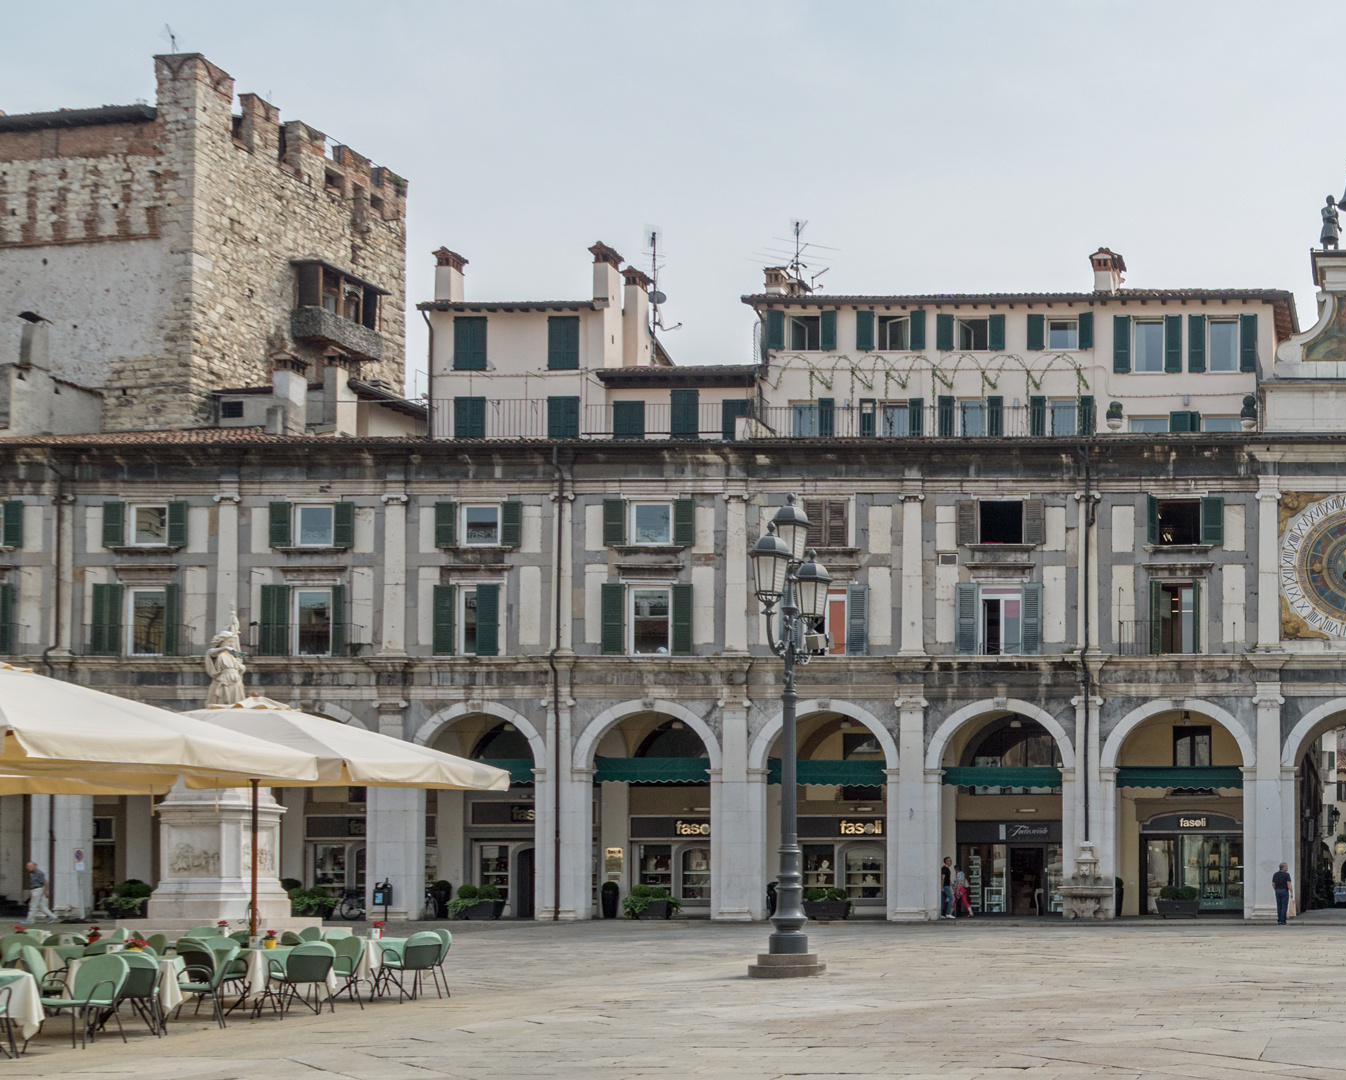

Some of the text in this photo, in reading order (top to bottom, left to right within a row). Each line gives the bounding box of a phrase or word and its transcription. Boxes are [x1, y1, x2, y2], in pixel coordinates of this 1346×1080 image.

[1322, 498, 1341, 514] XVII
[1306, 505, 1324, 523] XVI
[1294, 517, 1309, 536] XV
[1282, 568, 1295, 583] XII
[1286, 586, 1302, 600] XI
[1296, 601, 1310, 613] X
[840, 820, 883, 835] fasoli
[1179, 817, 1207, 828] fasoli
